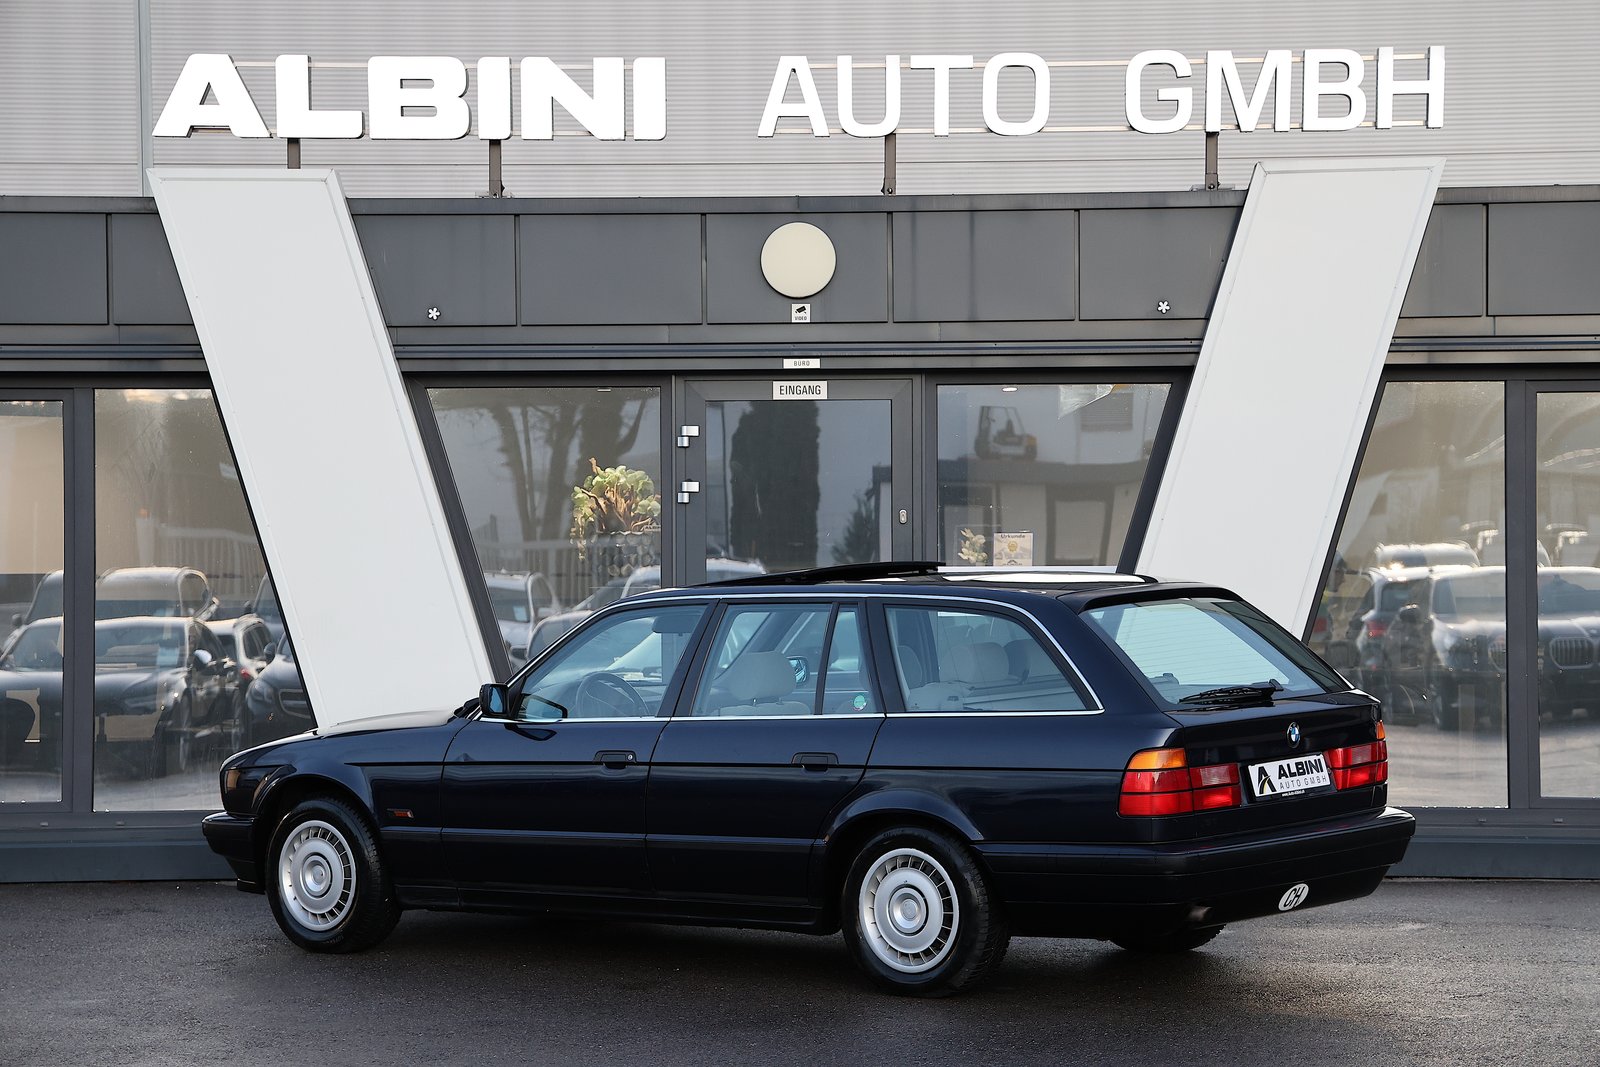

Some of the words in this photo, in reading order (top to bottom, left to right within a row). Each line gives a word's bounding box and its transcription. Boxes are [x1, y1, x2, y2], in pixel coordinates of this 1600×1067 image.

[152, 53, 668, 140] ALBINI
[757, 52, 1051, 137] AUTO
[1125, 45, 1446, 134] GMBH
[779, 384, 822, 396] EINGANG
[1278, 758, 1324, 780] ALBINI
[1280, 779, 1302, 790] AUTO
[1303, 775, 1327, 786] GMBH
[1283, 886, 1306, 908] CH
